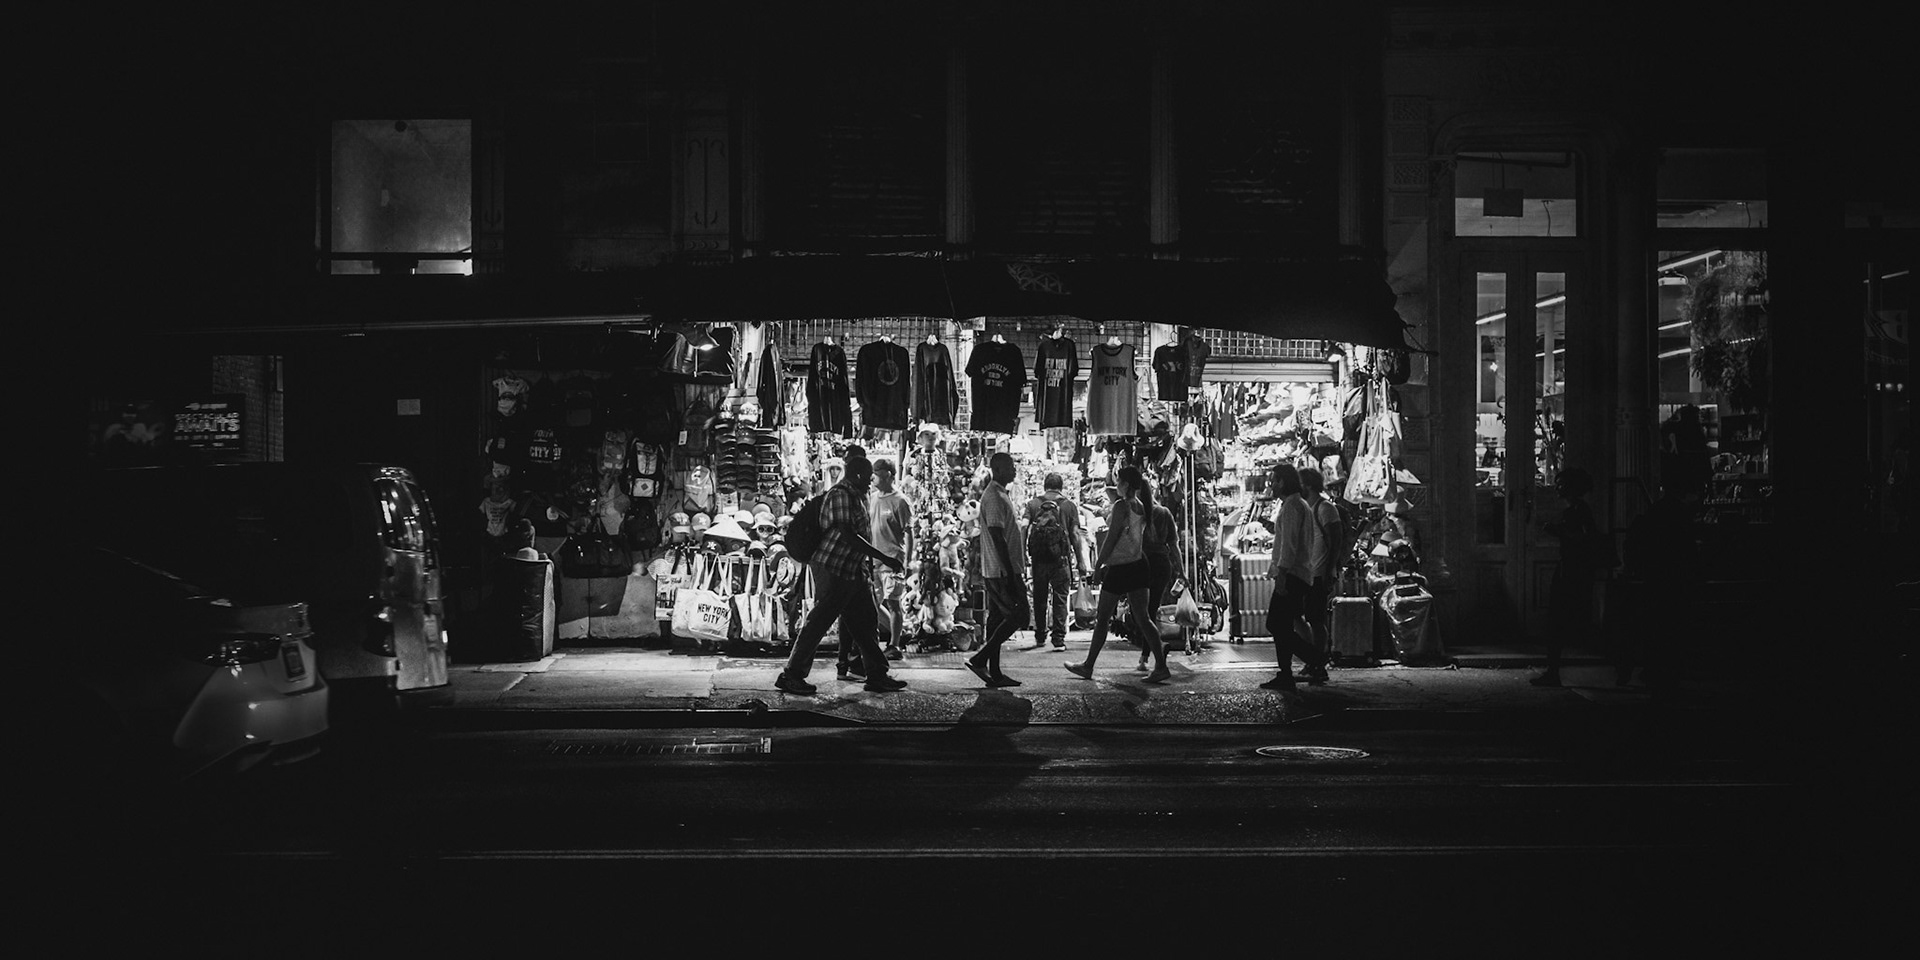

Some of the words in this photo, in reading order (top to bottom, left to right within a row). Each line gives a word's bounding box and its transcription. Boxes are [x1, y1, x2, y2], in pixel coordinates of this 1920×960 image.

[1112, 366, 1128, 378] YORK
[1047, 377, 1061, 387] CITY
[1104, 376, 1120, 386] CITY
[174, 419, 240, 432] AWAITS
[530, 446, 550, 458] CITY
[697, 603, 711, 613] NEW
[712, 605, 729, 620] YORK
[703, 613, 721, 624] CITY
